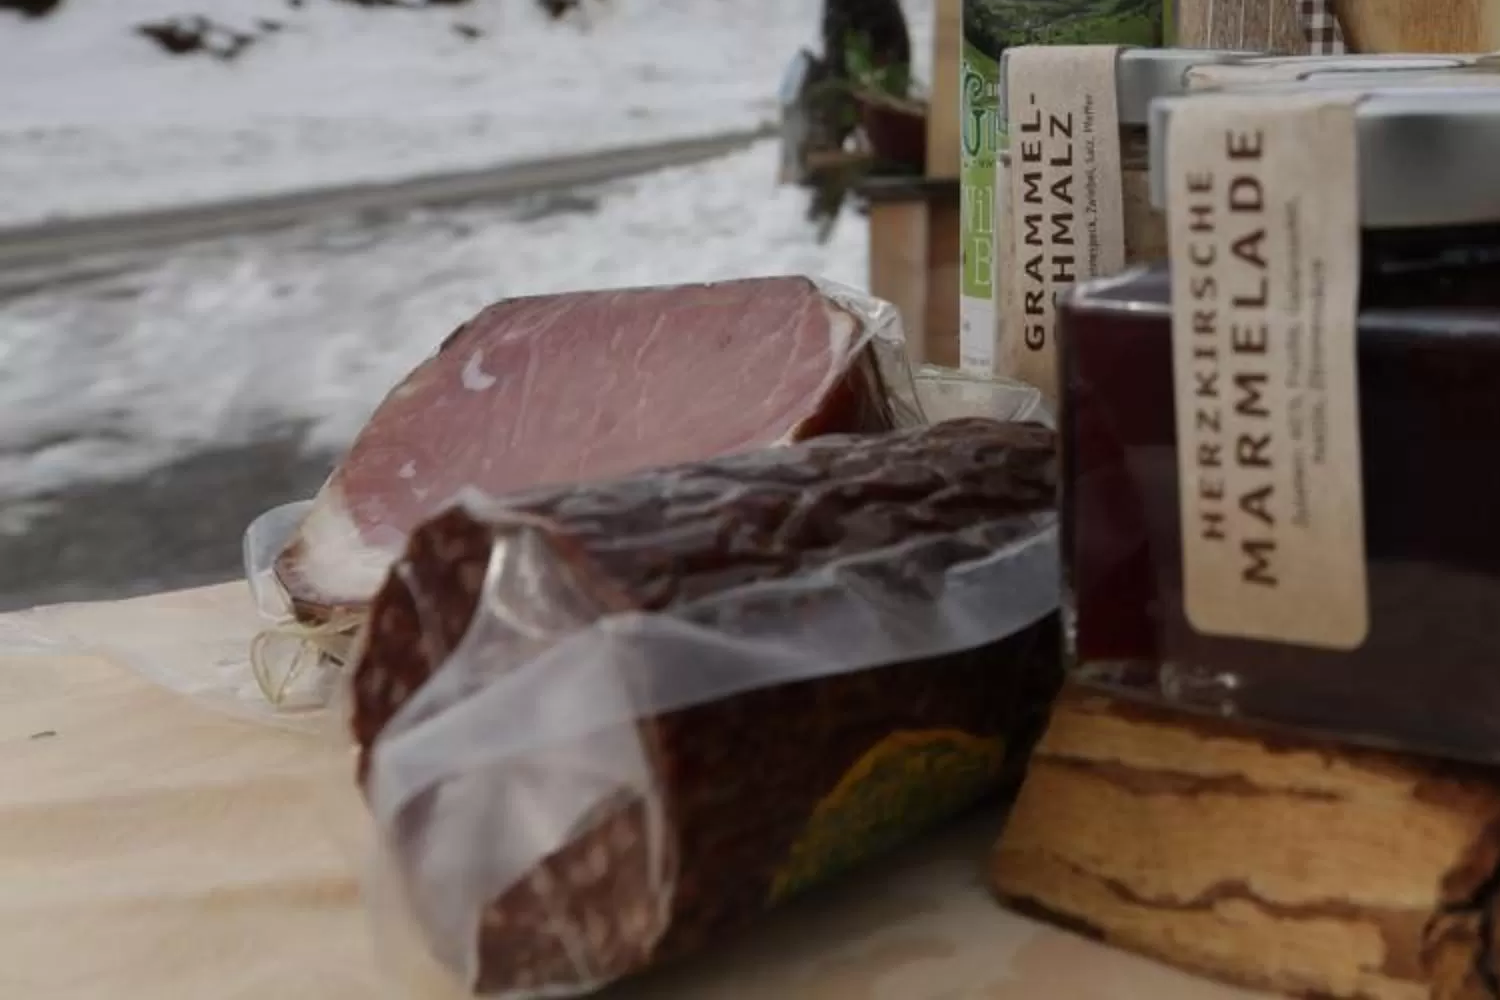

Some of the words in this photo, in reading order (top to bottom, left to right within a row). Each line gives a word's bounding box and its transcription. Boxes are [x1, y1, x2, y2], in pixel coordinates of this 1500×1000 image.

[1020, 93, 1046, 352] GRAMMEL-
[1050, 112, 1076, 342] HMALZ
[1187, 171, 1225, 542] HERZKIRSCHE
[1227, 129, 1278, 587] MARMELADE
